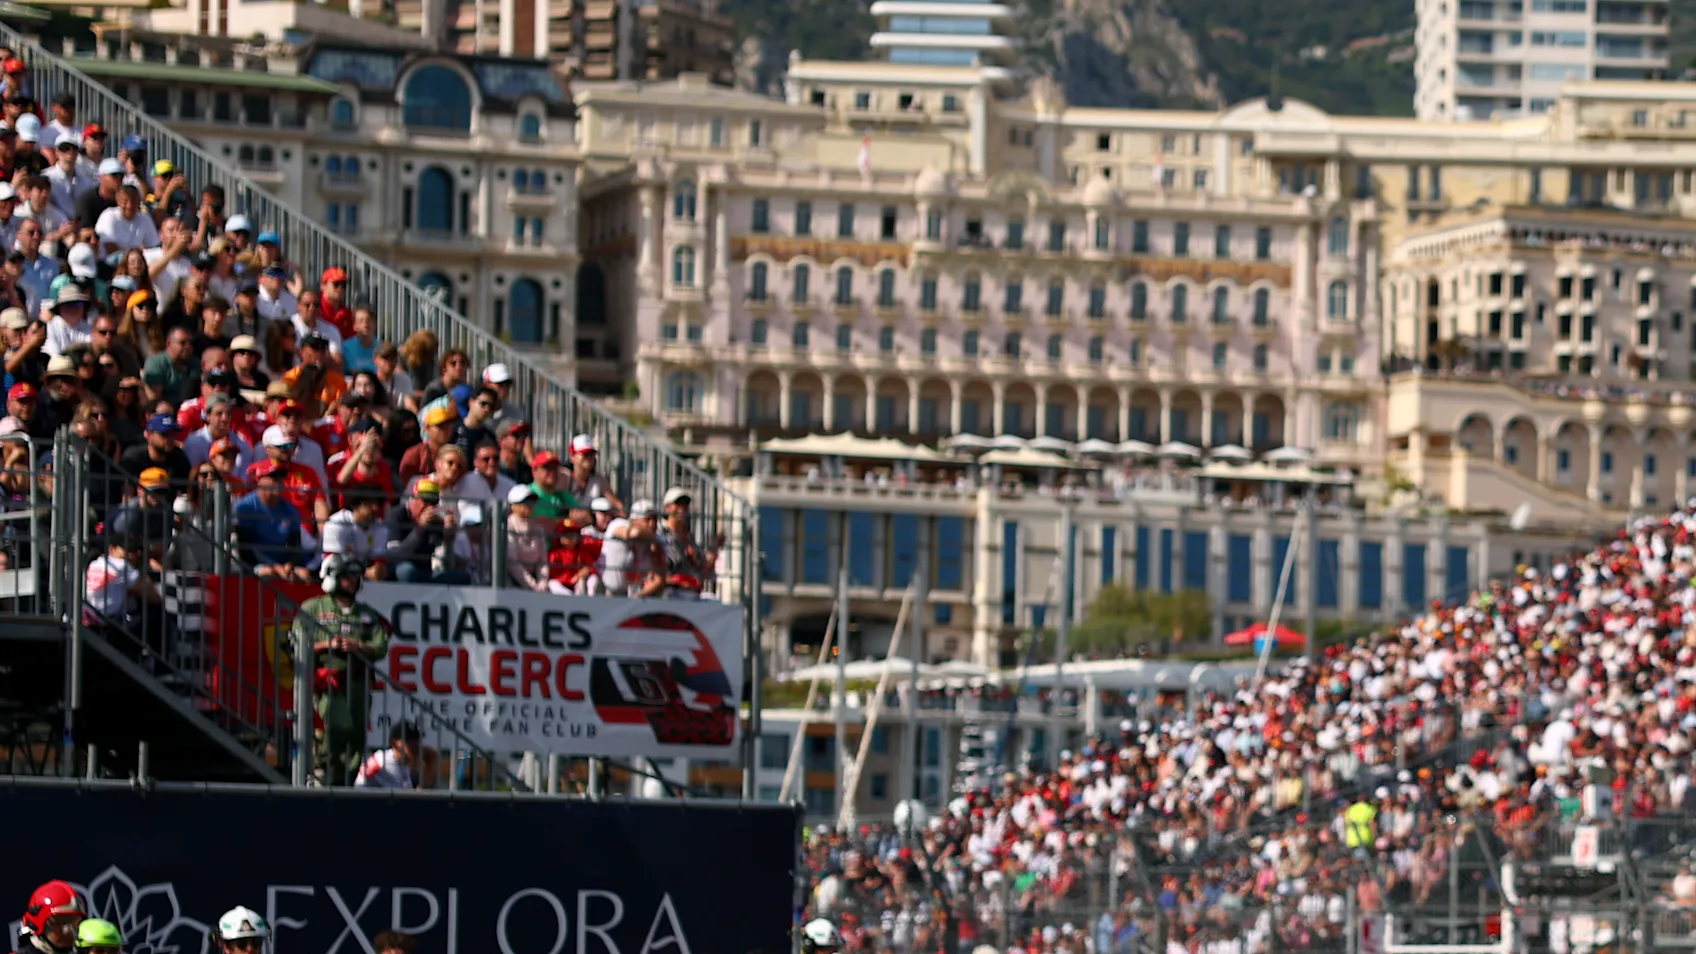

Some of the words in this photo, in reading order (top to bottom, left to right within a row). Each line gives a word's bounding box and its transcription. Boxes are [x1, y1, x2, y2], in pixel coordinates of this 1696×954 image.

[391, 601, 592, 649] CHARLES
[372, 645, 585, 699] ECLERC
[465, 701, 567, 721] OFFICIAL
[490, 718, 528, 736] FAN
[542, 721, 597, 739] CLUB
